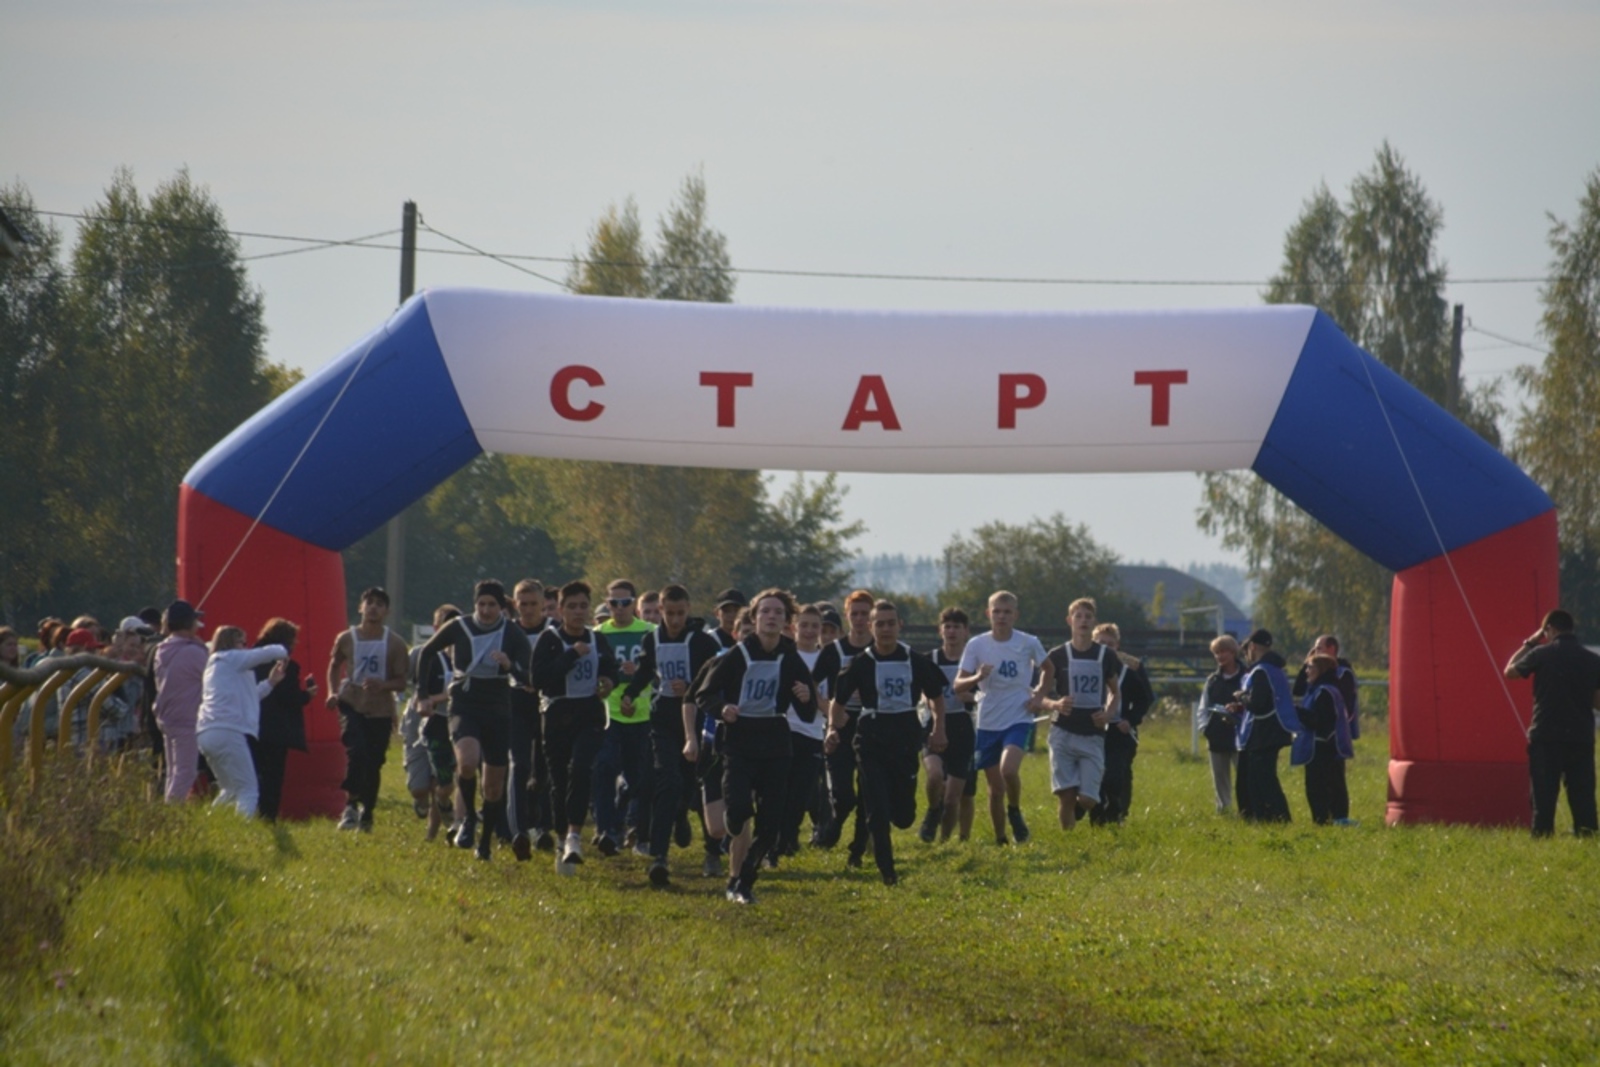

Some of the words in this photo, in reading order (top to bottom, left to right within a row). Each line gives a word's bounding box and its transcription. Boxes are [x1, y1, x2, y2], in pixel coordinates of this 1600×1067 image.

[549, 365, 1189, 432] СТАРТ
[574, 659, 593, 681] 39
[660, 660, 686, 681] 105
[998, 660, 1018, 678] 48
[746, 679, 777, 701] 104
[884, 678, 905, 697] 53
[1072, 675, 1099, 693] 122
